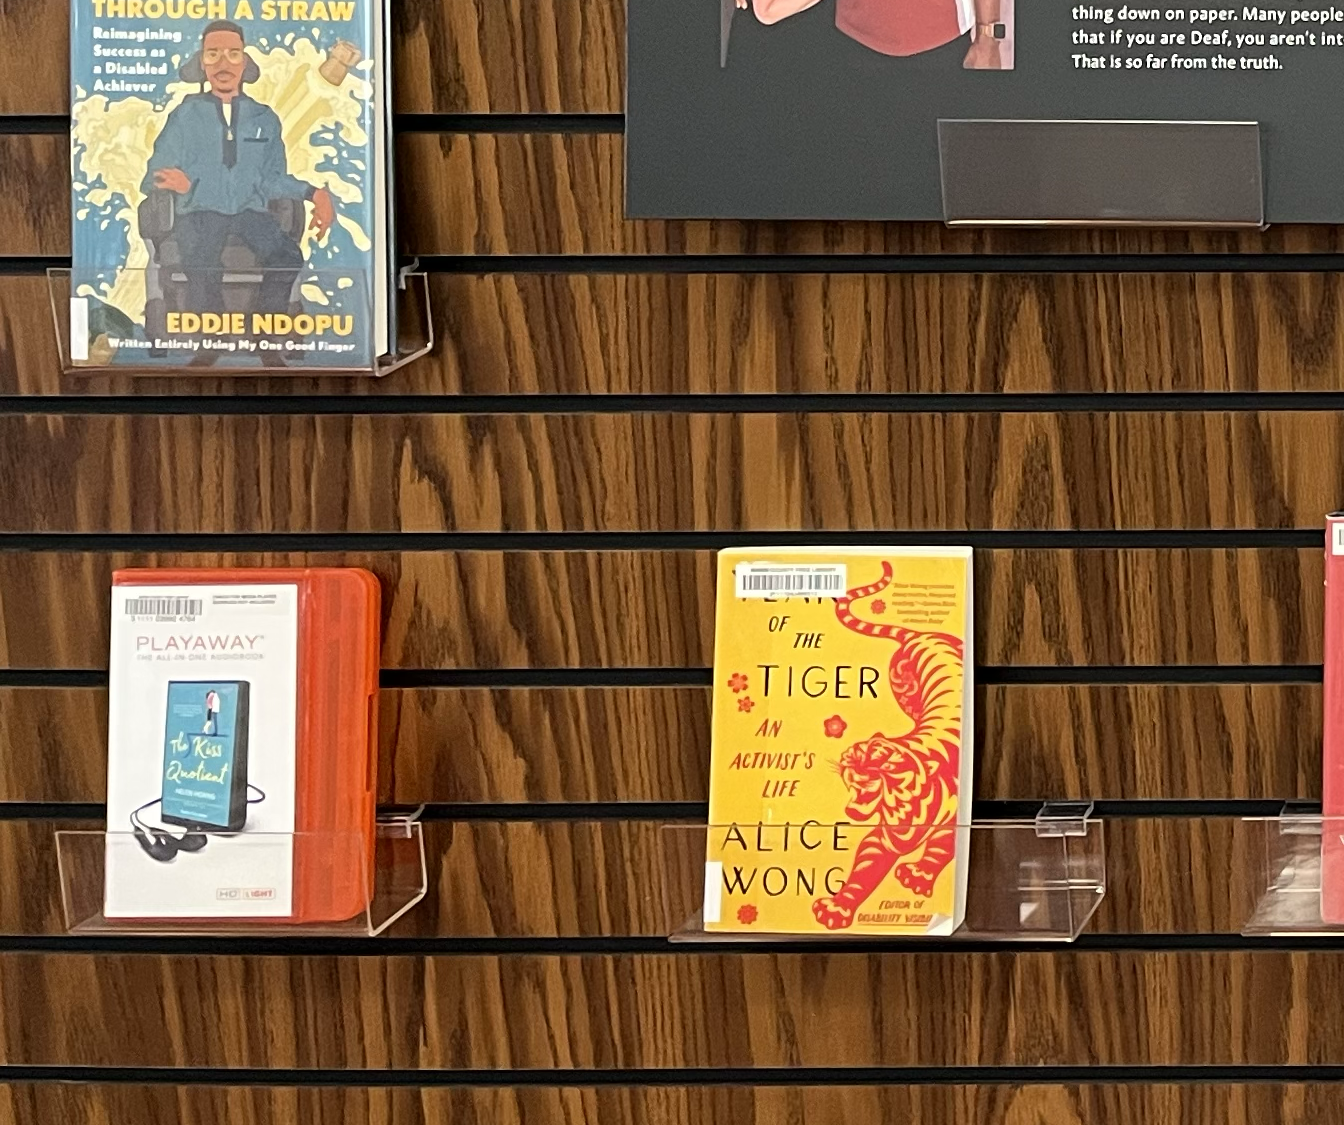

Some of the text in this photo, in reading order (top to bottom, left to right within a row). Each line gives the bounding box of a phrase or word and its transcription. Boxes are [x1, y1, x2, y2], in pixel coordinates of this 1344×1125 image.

[233, 1, 254, 20] A
[261, 0, 355, 21] STRAW
[93, 27, 182, 42] Reimagining
[93, 44, 165, 57] Success as
[93, 62, 167, 75] a Disabled
[93, 79, 156, 91] Achiever
[167, 313, 353, 336] EDDIE NDOPU
[108, 338, 355, 353] Written Entirely Using My One Good Finger
[769, 616, 789, 632] OF
[794, 633, 825, 649] THE
[757, 665, 880, 699] TIGER
[755, 719, 782, 737] AN
[171, 733, 222, 760] The Kiss
[729, 751, 816, 770] ACTIVIST'S
[166, 761, 229, 787] Quotient
[762, 780, 800, 798] LIFE
[721, 820, 851, 852] ALICE
[721, 866, 847, 896] WONG
